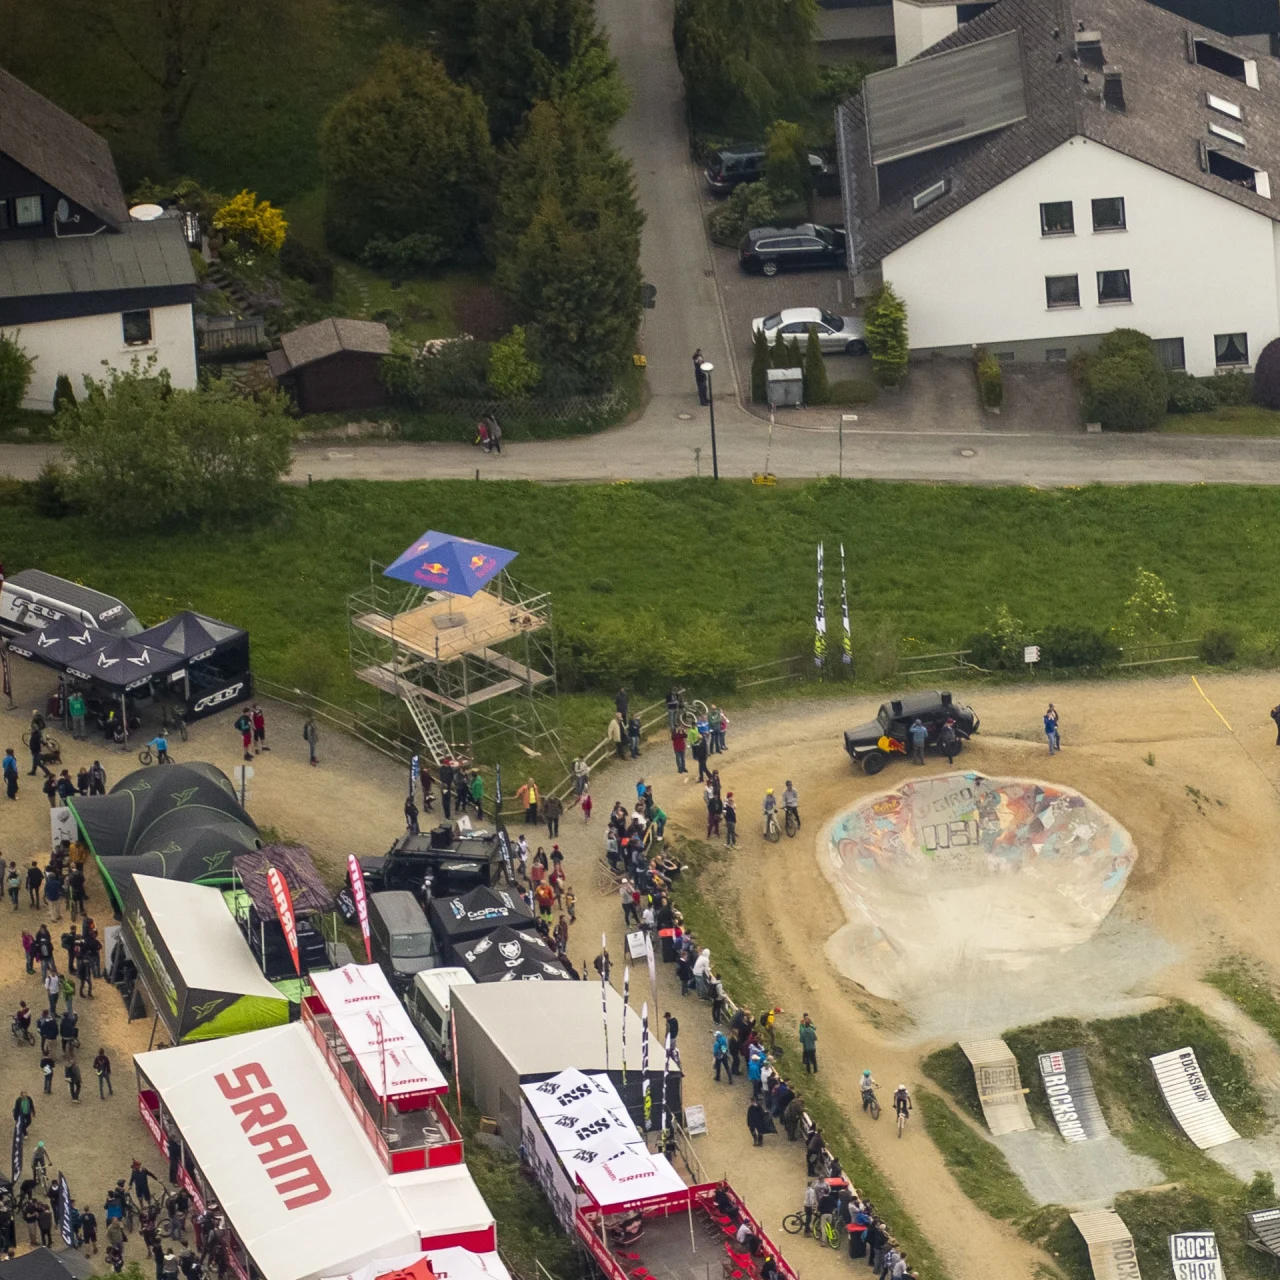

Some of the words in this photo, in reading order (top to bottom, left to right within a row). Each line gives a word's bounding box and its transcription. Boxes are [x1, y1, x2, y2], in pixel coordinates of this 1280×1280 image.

[12, 597, 67, 621] FELT
[194, 682, 243, 712] FELT
[467, 906, 508, 919] GoPro
[344, 994, 381, 1005] SRAM
[391, 1077, 428, 1087] SRAM
[1178, 1052, 1210, 1103] ROCKSHOX
[1044, 1074, 1089, 1143] ROCKSHOX
[214, 1061, 332, 1211] SRAM
[618, 1171, 655, 1184] SRAM
[1176, 1236, 1216, 1259] ROCK
